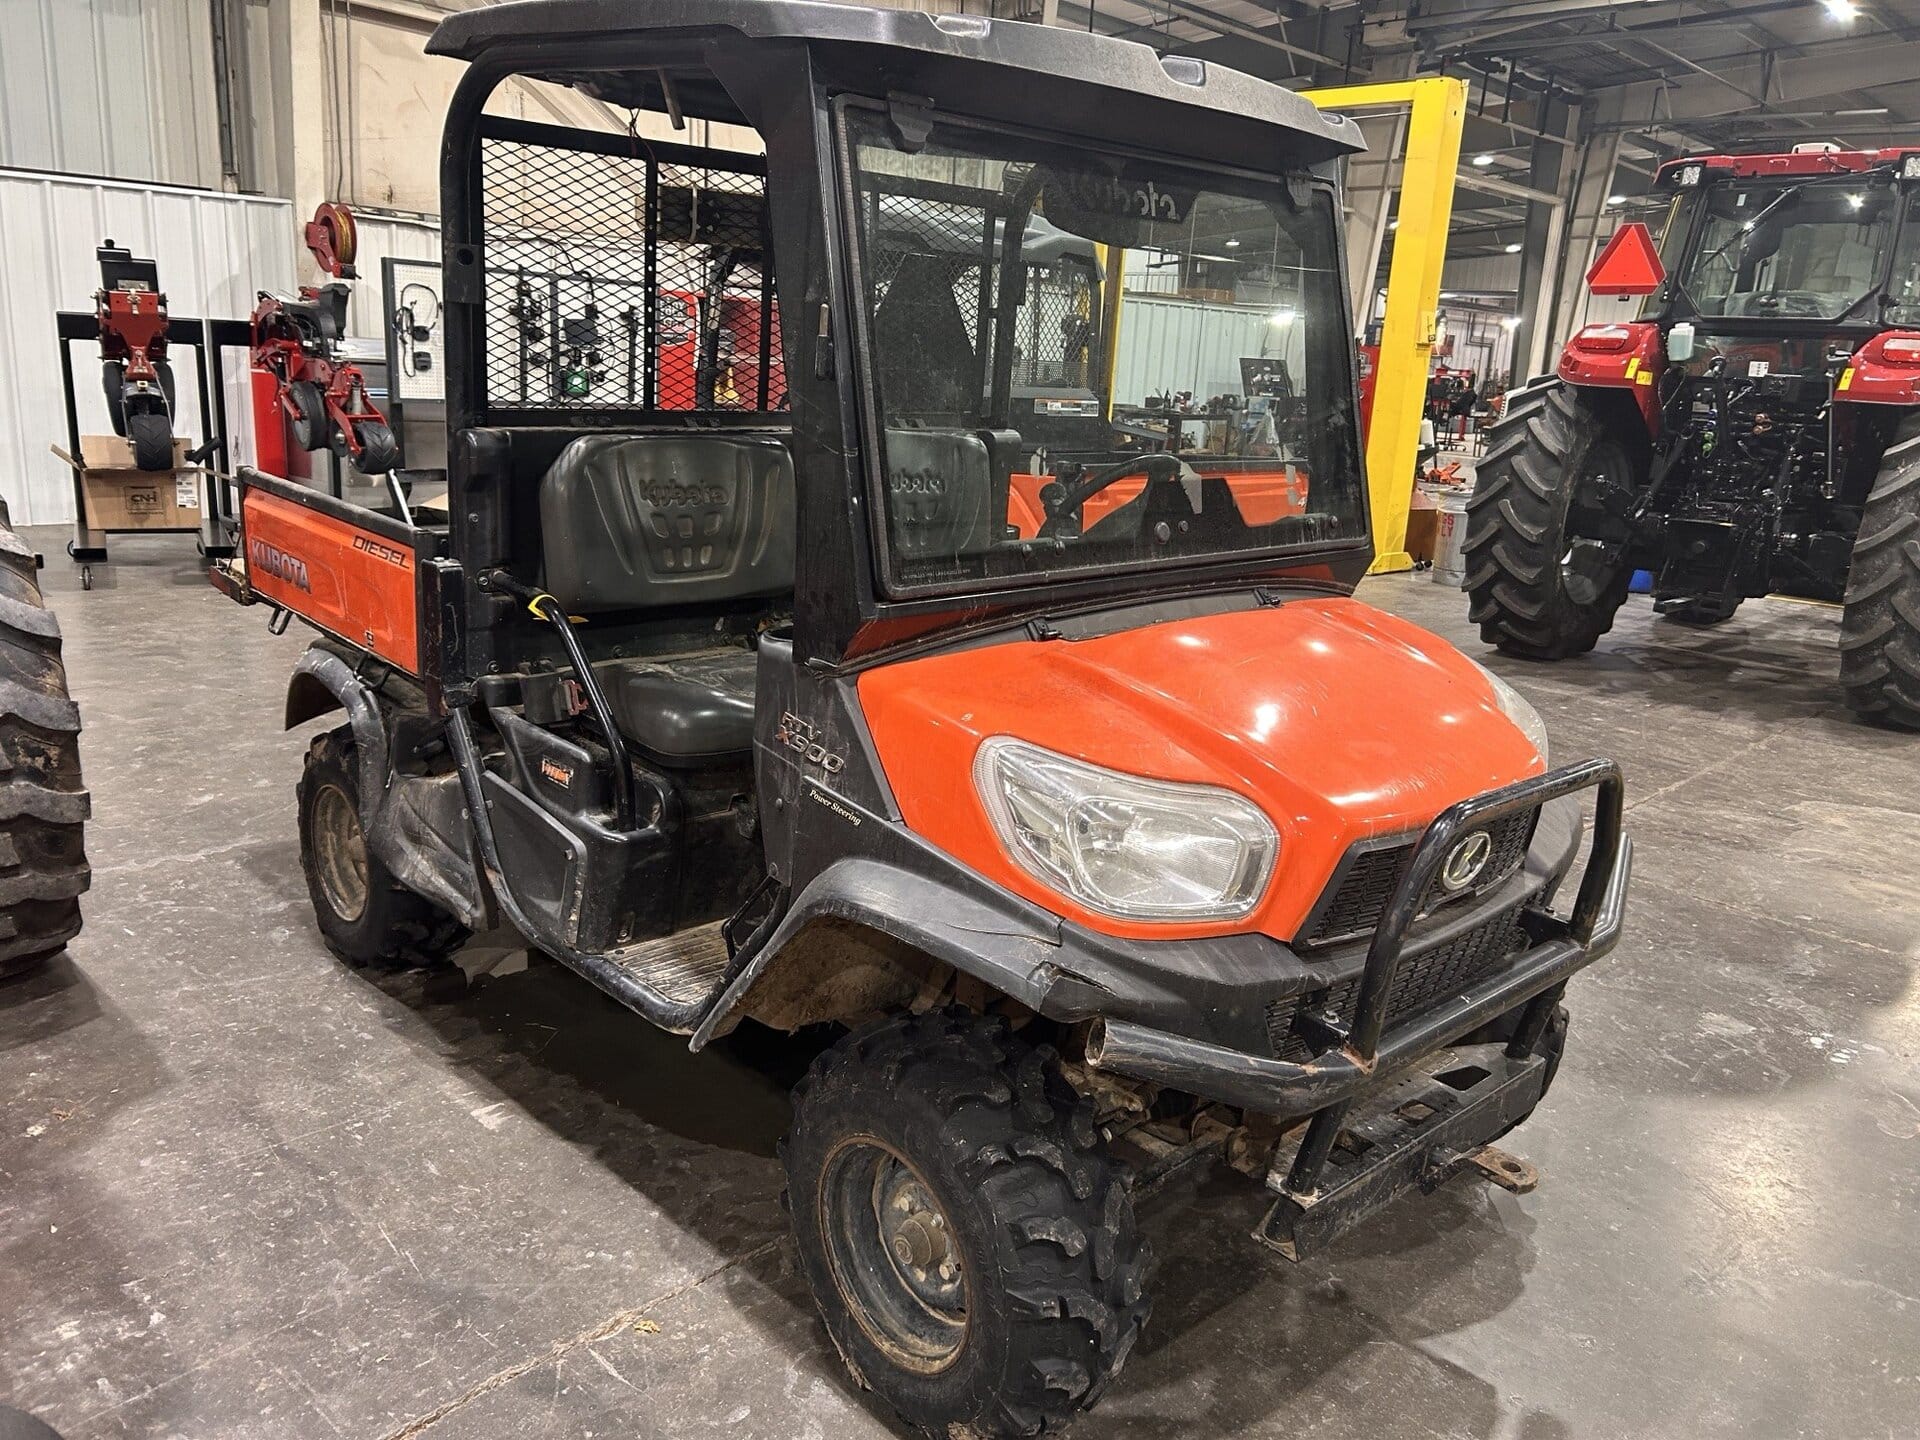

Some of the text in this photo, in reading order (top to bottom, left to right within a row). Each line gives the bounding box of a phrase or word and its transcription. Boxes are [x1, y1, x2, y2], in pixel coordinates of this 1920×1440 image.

[251, 540, 312, 594] KUBOTA
[353, 535, 410, 569] DIESEL
[781, 711, 822, 740] RTV
[775, 724, 845, 774] X900
[809, 789, 862, 826] Power Steering
